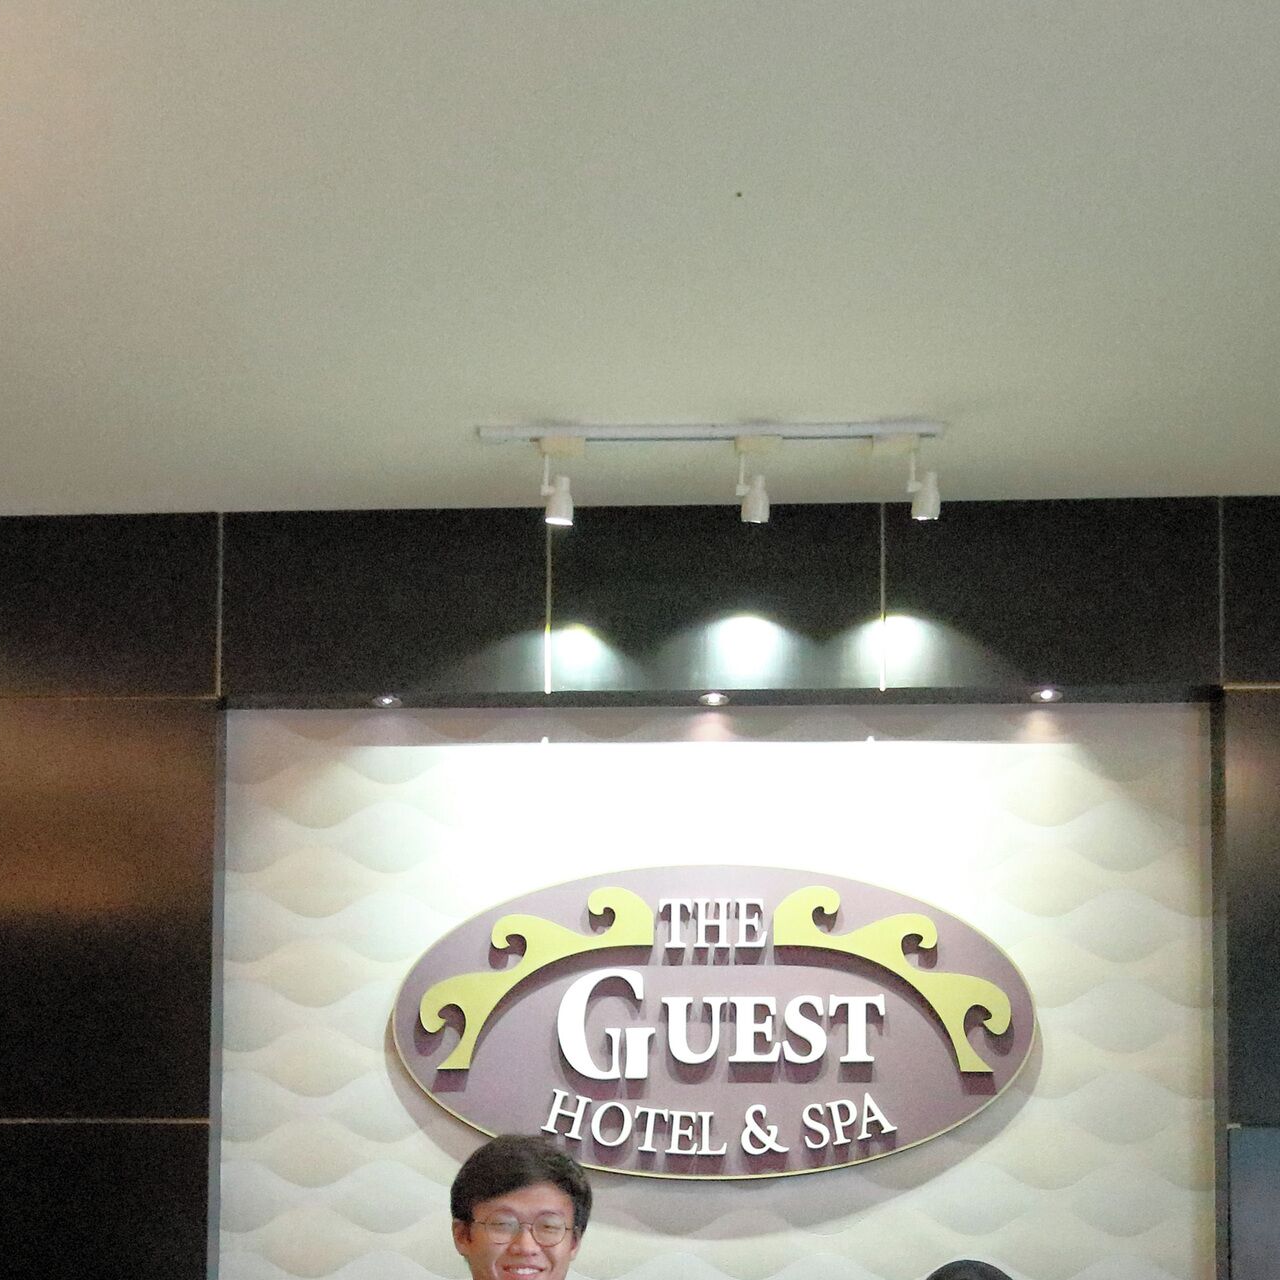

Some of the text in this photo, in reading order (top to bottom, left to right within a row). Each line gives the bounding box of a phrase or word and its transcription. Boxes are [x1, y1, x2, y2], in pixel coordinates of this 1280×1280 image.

[658, 897, 768, 949] THE
[556, 968, 886, 1081] GUEST
[540, 1087, 899, 1157] HOTEL & SPA
